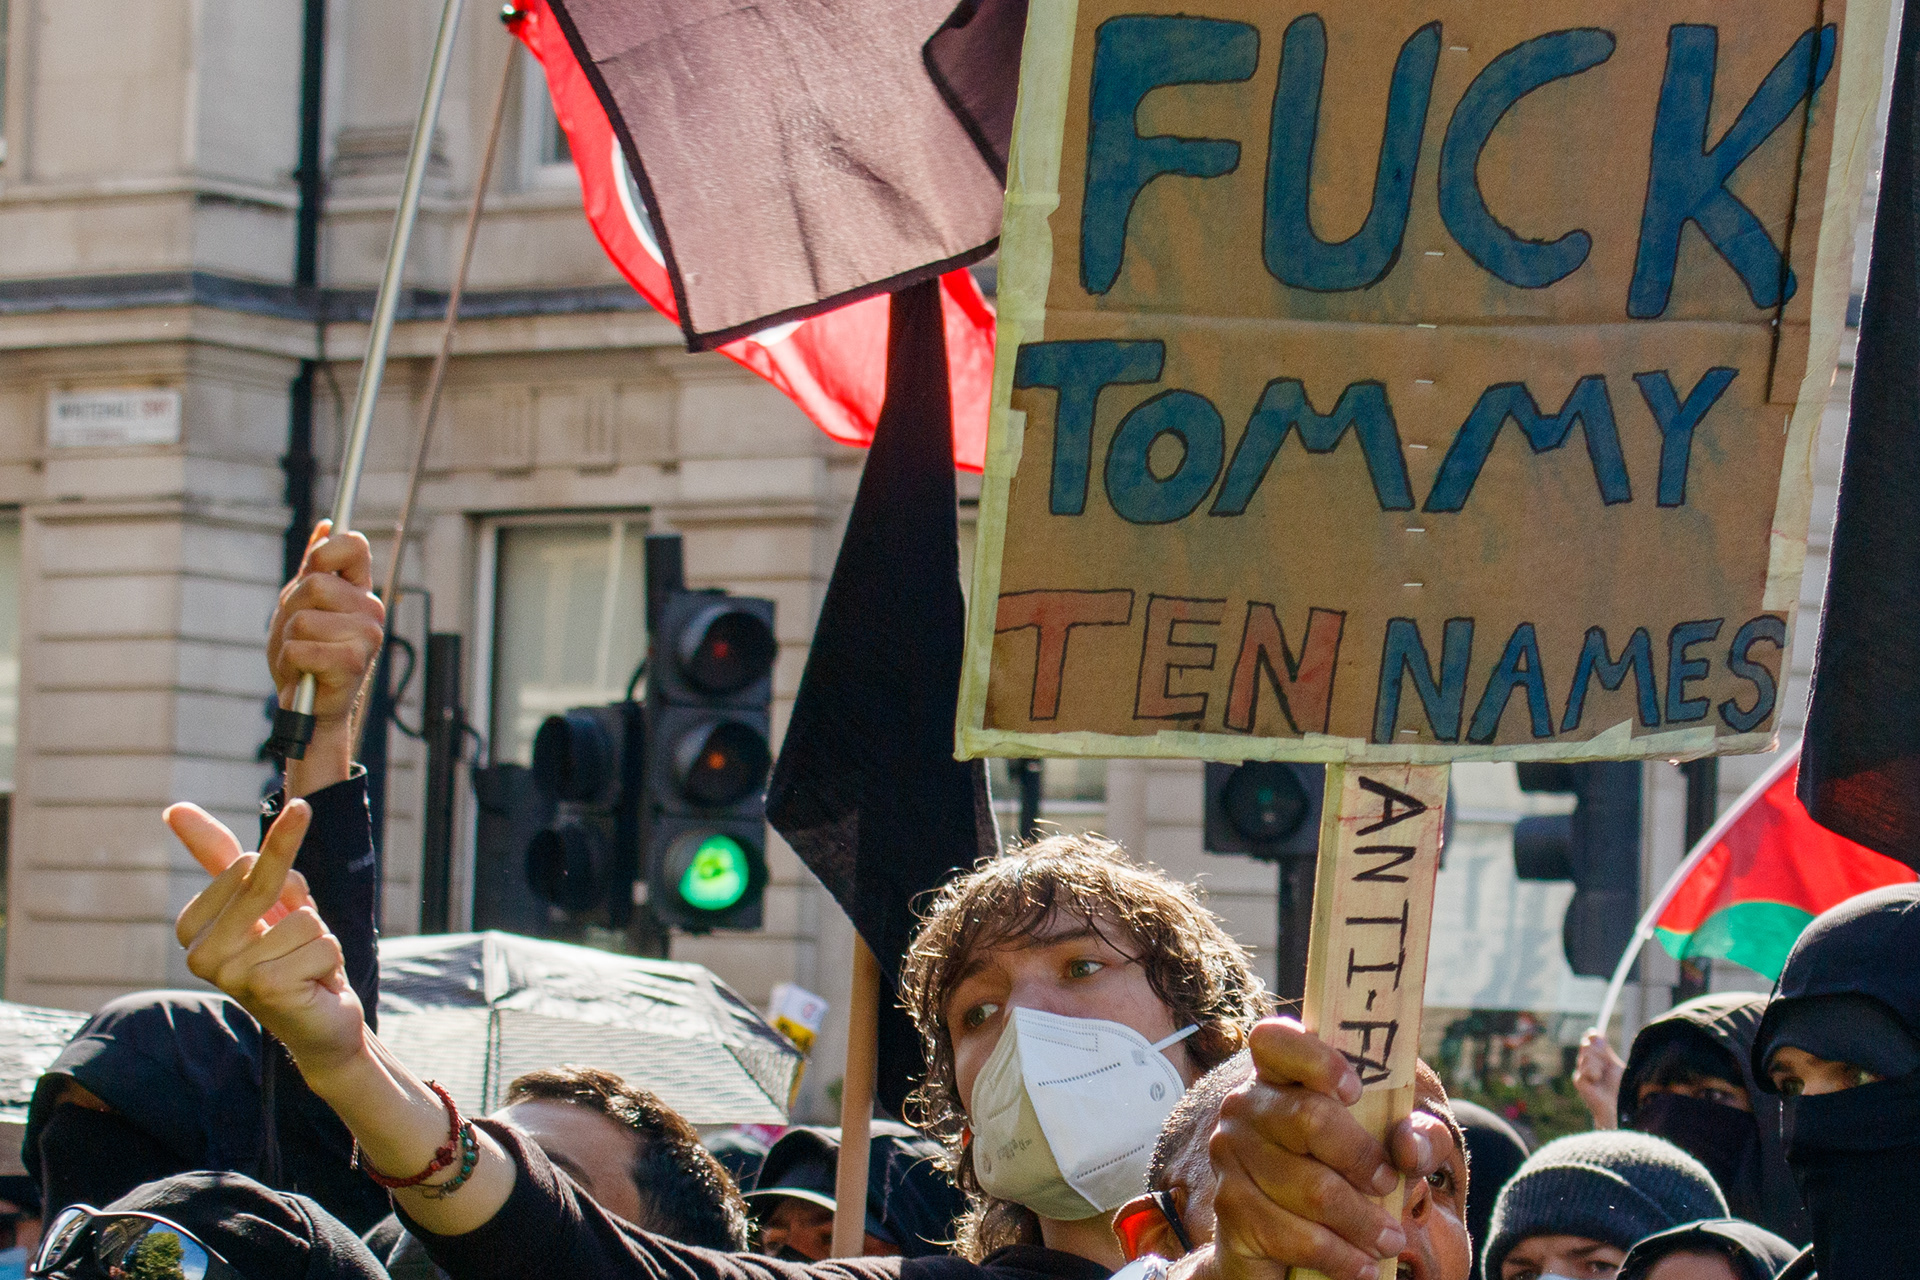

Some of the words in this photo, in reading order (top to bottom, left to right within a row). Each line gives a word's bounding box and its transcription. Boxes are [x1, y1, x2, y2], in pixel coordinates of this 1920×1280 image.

[1080, 12, 1837, 319] FUCK
[1014, 338, 1739, 524] TOMMY
[995, 588, 1347, 735] TEN
[1371, 615, 1786, 744] NAMES
